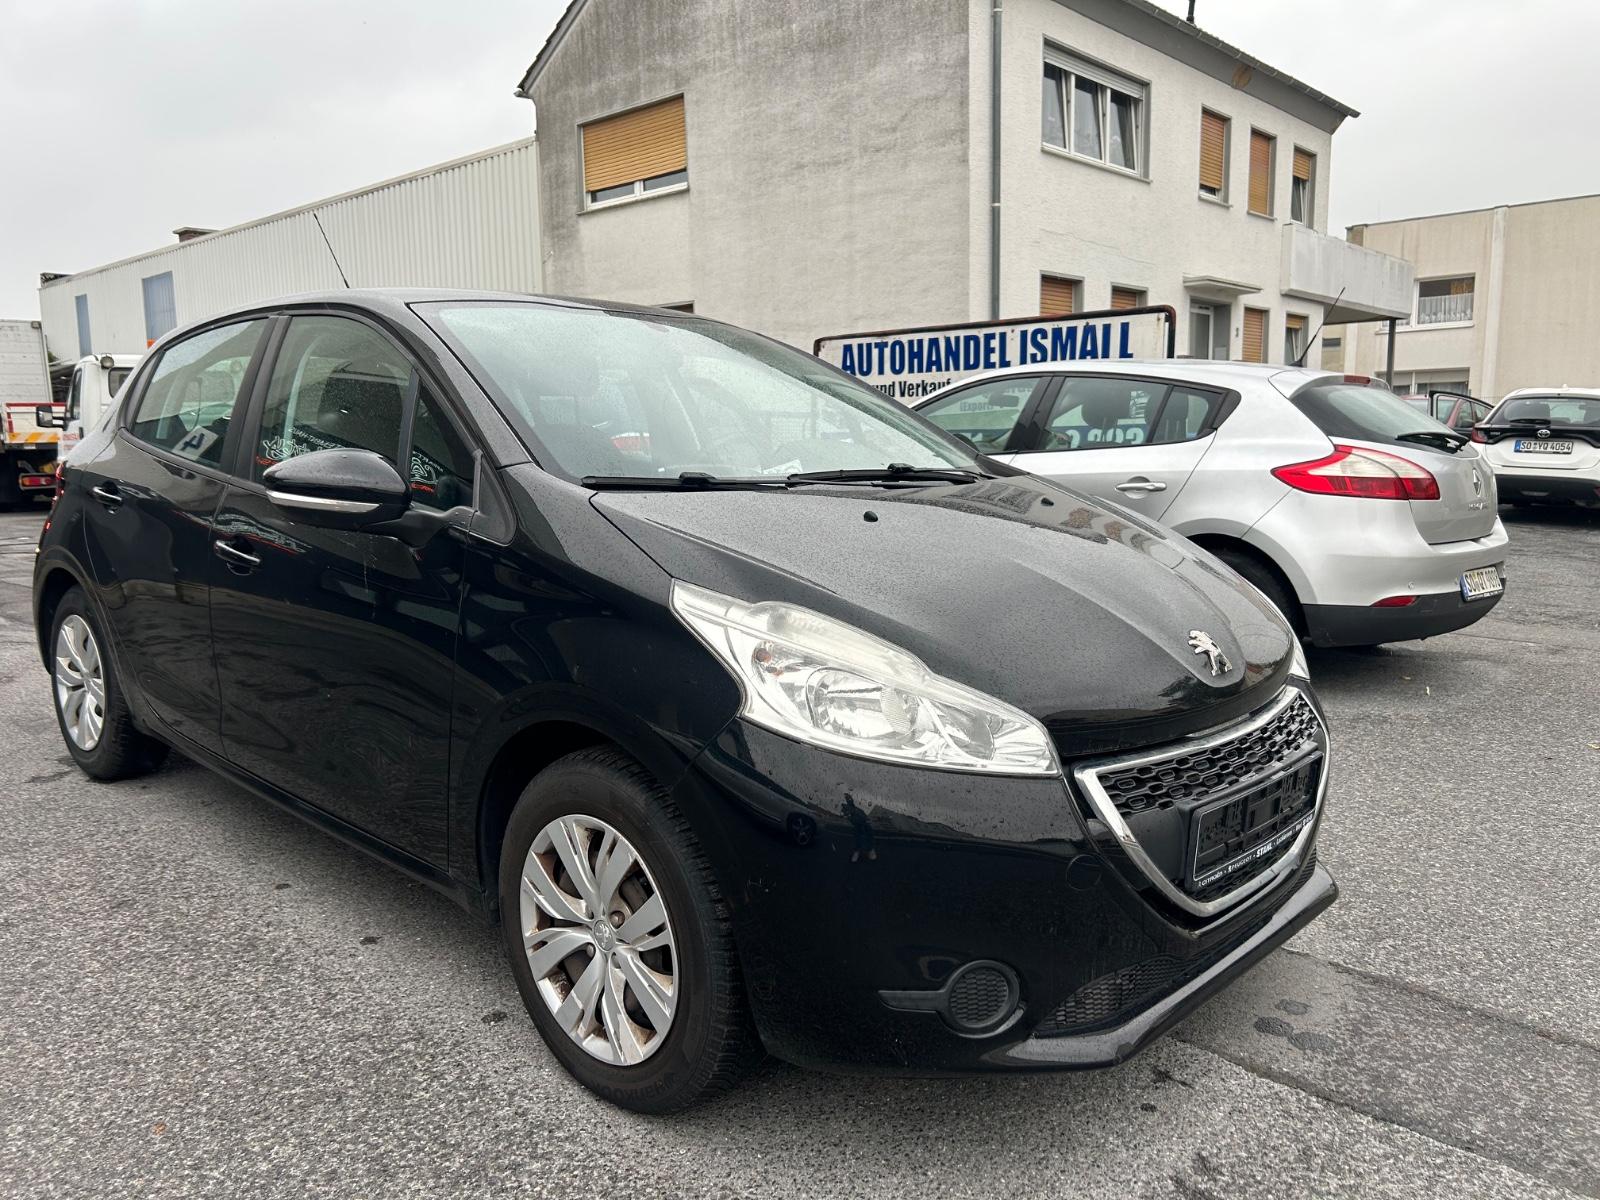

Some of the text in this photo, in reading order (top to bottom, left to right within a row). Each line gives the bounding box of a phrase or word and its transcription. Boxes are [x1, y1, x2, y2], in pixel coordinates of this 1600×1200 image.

[841, 322, 1133, 377] AUTOHANDEL ISMAIL
[875, 381, 895, 397] nd
[1521, 441, 1532, 449] SO
[1550, 442, 1571, 451] 4054
